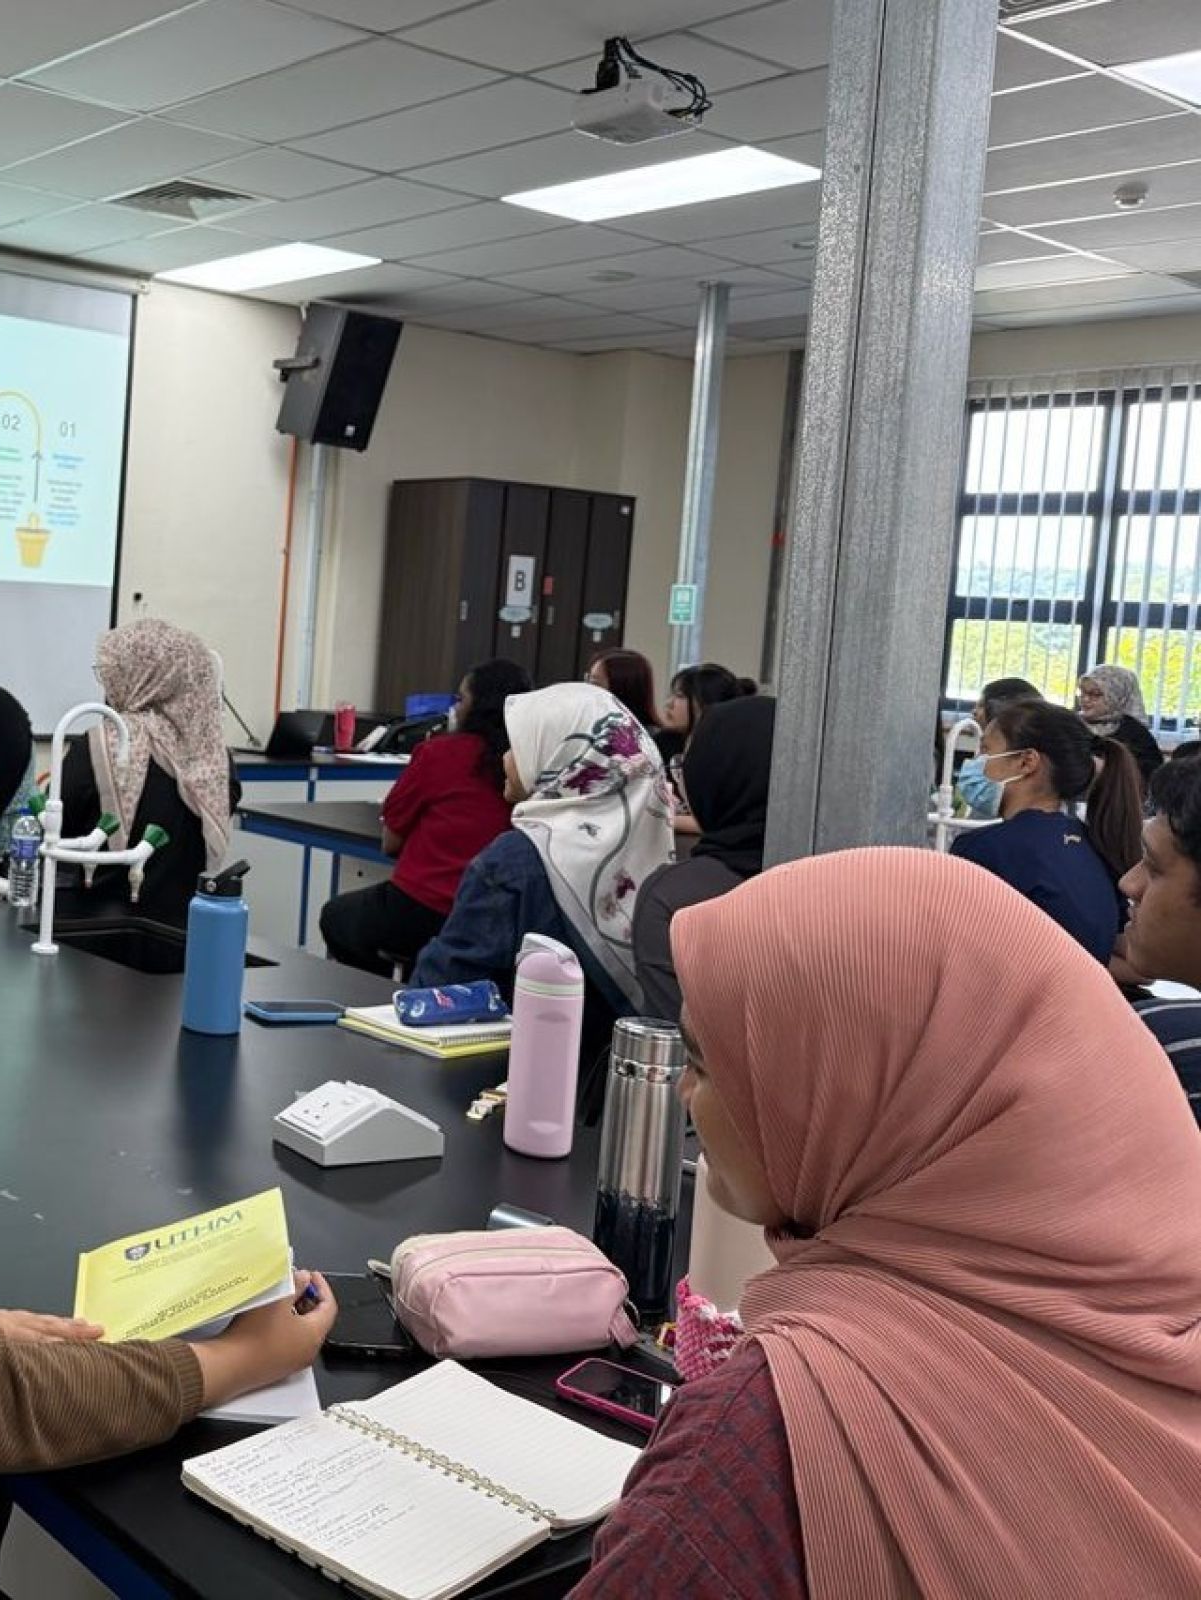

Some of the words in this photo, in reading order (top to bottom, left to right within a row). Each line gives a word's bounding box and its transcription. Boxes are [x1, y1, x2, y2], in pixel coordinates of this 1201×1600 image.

[1, 413, 21, 431] 02
[59, 420, 77, 438] 01
[514, 569, 527, 592] B
[153, 1208, 242, 1250] UTHM
